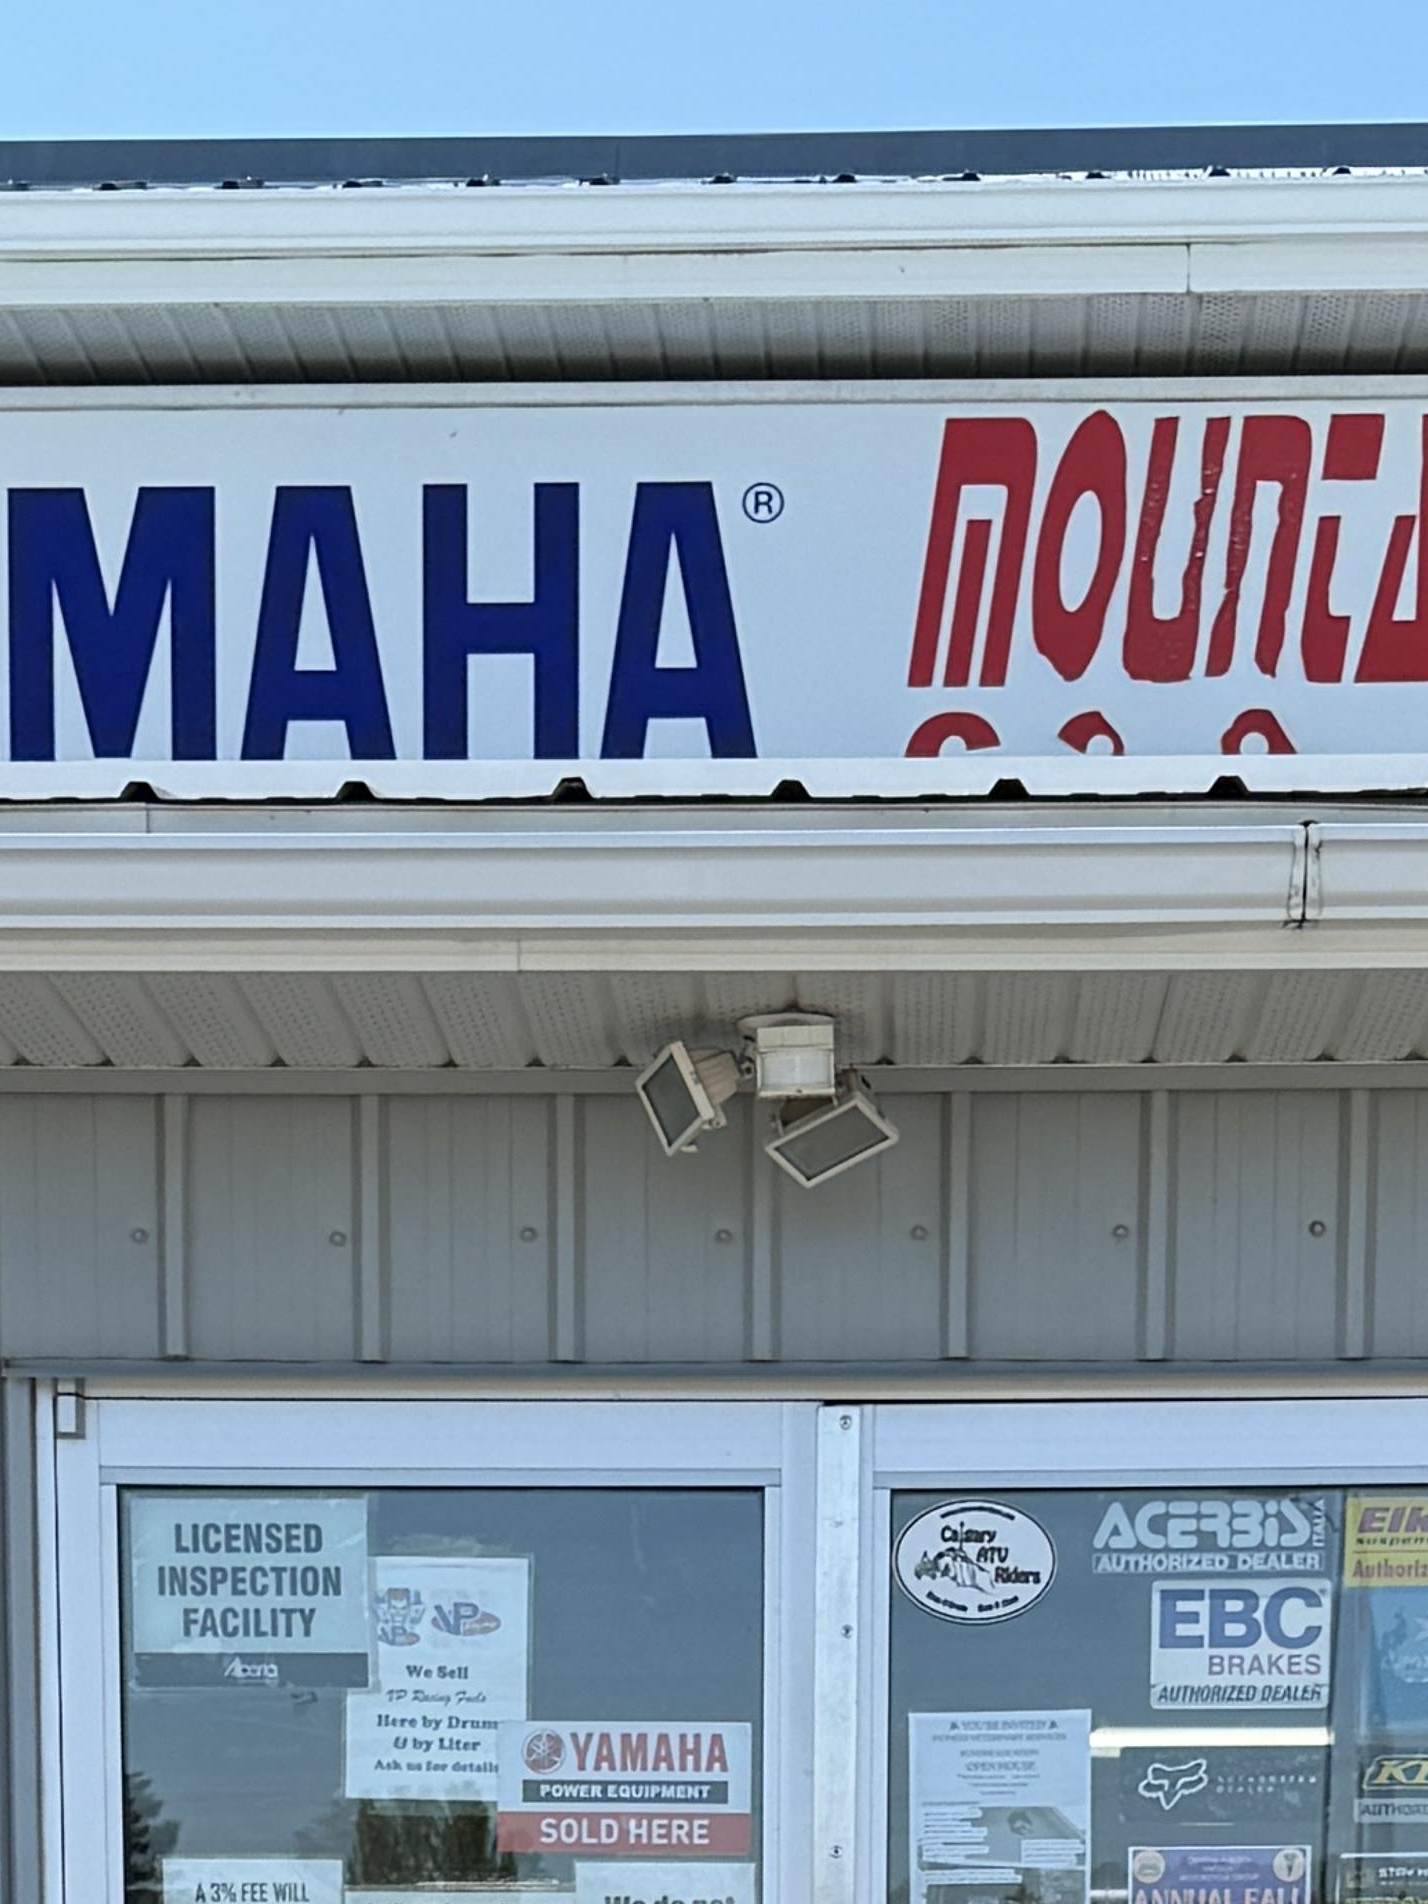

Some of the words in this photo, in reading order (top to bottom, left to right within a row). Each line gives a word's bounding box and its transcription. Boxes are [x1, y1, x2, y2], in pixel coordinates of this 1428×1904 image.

[1092, 1500, 1312, 1549] ACERBIS
[174, 1523, 323, 1554] LICENSED
[1097, 1553, 1229, 1572] AUTHORIZED
[1237, 1553, 1321, 1571] DEALER
[157, 1566, 342, 1597] INSPECTION
[182, 1608, 317, 1638] FACILITY
[1159, 1587, 1323, 1649] EBC
[405, 1665, 433, 1679] We
[437, 1665, 469, 1680] Sell
[1208, 1654, 1322, 1676] BRAKES
[1158, 1685, 1257, 1702] AUTHORIZED
[1260, 1685, 1322, 1701] DEALER
[376, 1714, 418, 1728] Here
[422, 1715, 442, 1730] by
[412, 1736, 434, 1751] by
[438, 1737, 481, 1751] Liter
[570, 1732, 729, 1773] YAMAHA
[374, 1759, 402, 1772] Ask
[540, 1784, 602, 1798] POWER
[607, 1784, 711, 1799] EQUIPMENT
[540, 1818, 619, 1844] SOLD
[628, 1819, 711, 1845] HERE
[195, 1883, 206, 1903] A
[210, 1883, 236, 1902] 3%
[241, 1883, 269, 1902] FEE
[272, 1883, 310, 1902] WILL
